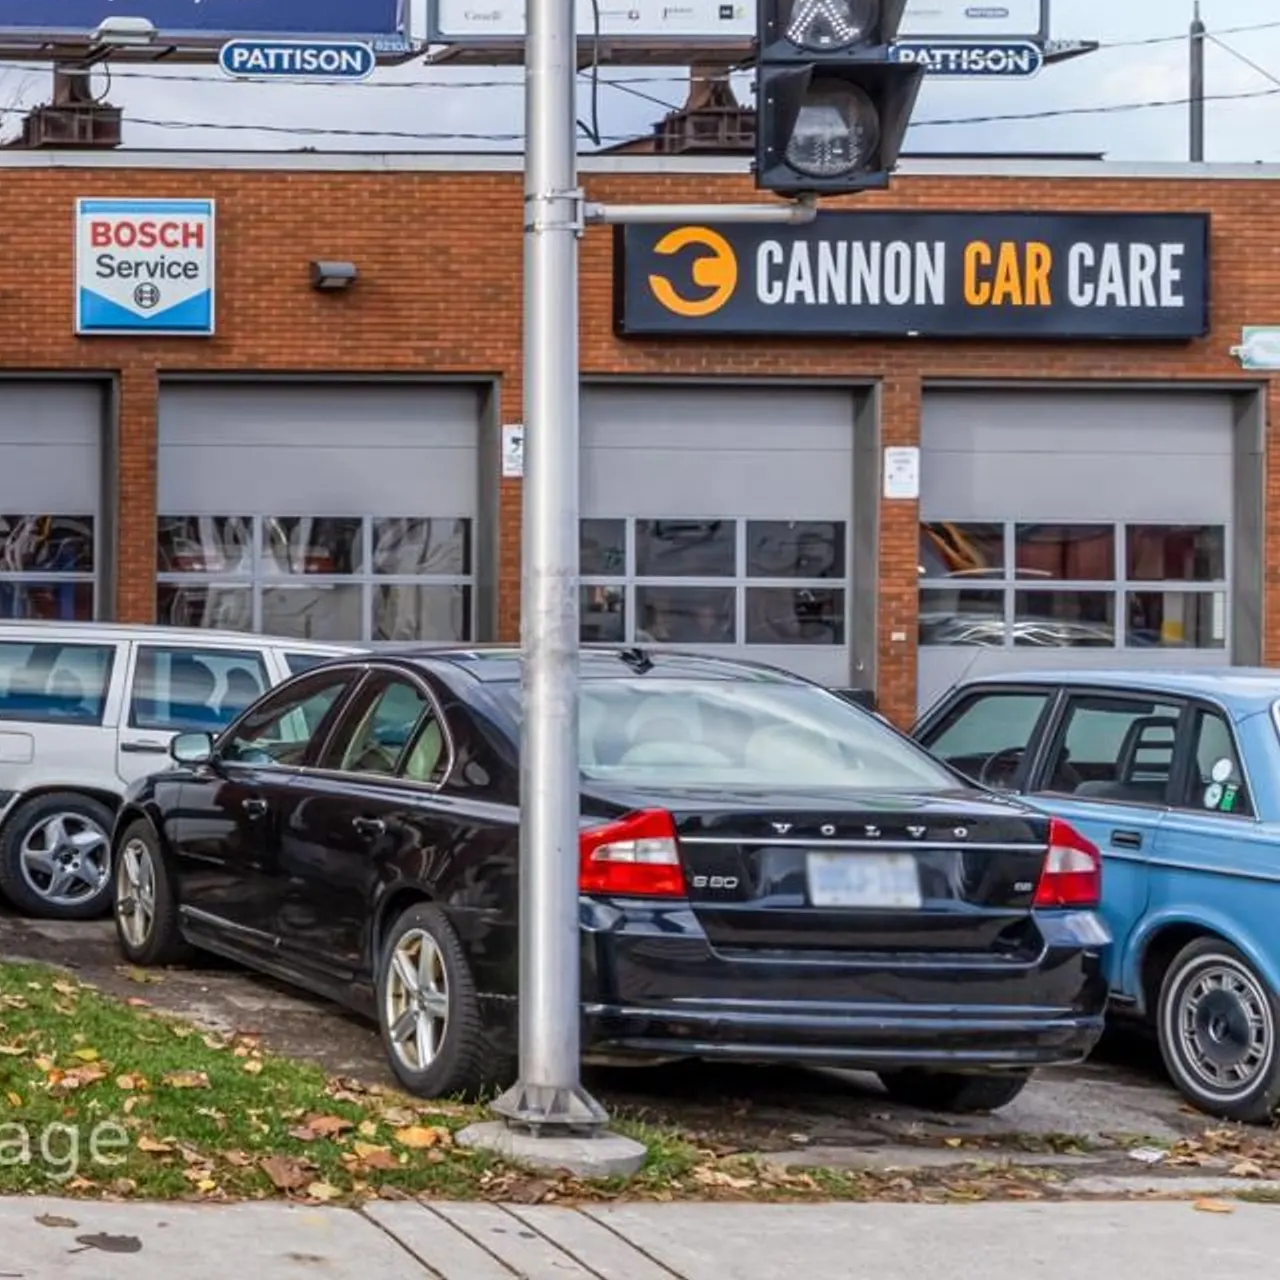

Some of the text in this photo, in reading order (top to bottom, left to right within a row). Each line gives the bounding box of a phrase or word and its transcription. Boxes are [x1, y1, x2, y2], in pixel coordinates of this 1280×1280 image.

[232, 48, 363, 71] PATTISON
[899, 48, 1030, 71] PATTISON
[90, 221, 204, 248] BOSCH
[96, 253, 199, 279] Service
[756, 240, 1185, 308] CANNON CAR CARE
[772, 822, 969, 838] VOLVO
